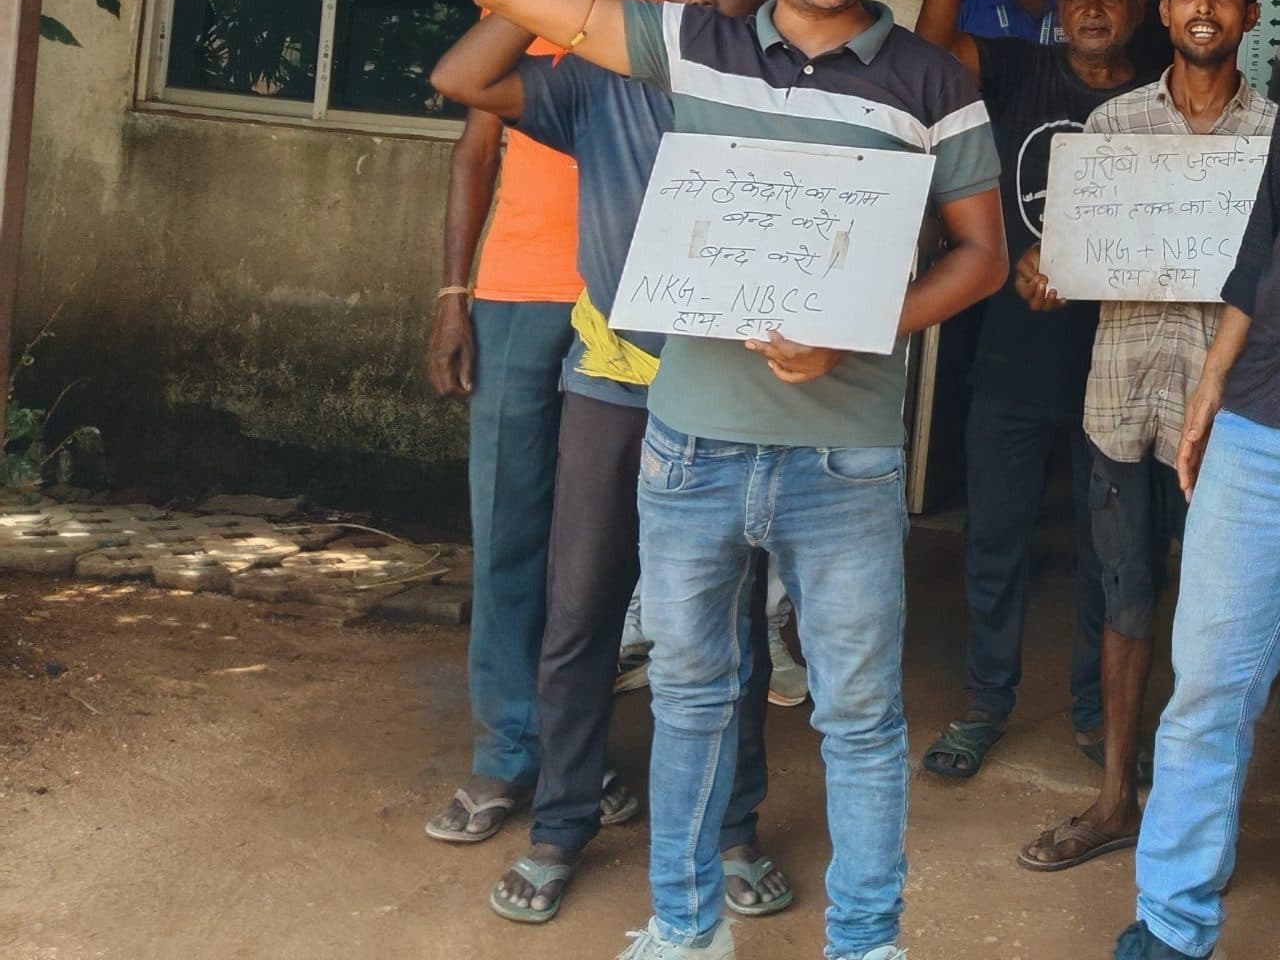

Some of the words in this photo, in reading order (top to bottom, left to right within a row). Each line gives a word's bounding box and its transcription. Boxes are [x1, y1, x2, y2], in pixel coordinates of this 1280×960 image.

[805, 187, 837, 204] का
[839, 190, 890, 207] काम
[1085, 238, 1130, 265] NKG
[1162, 236, 1234, 262] NBCC
[630, 274, 695, 307] NKG
[731, 283, 822, 314] NBCC
